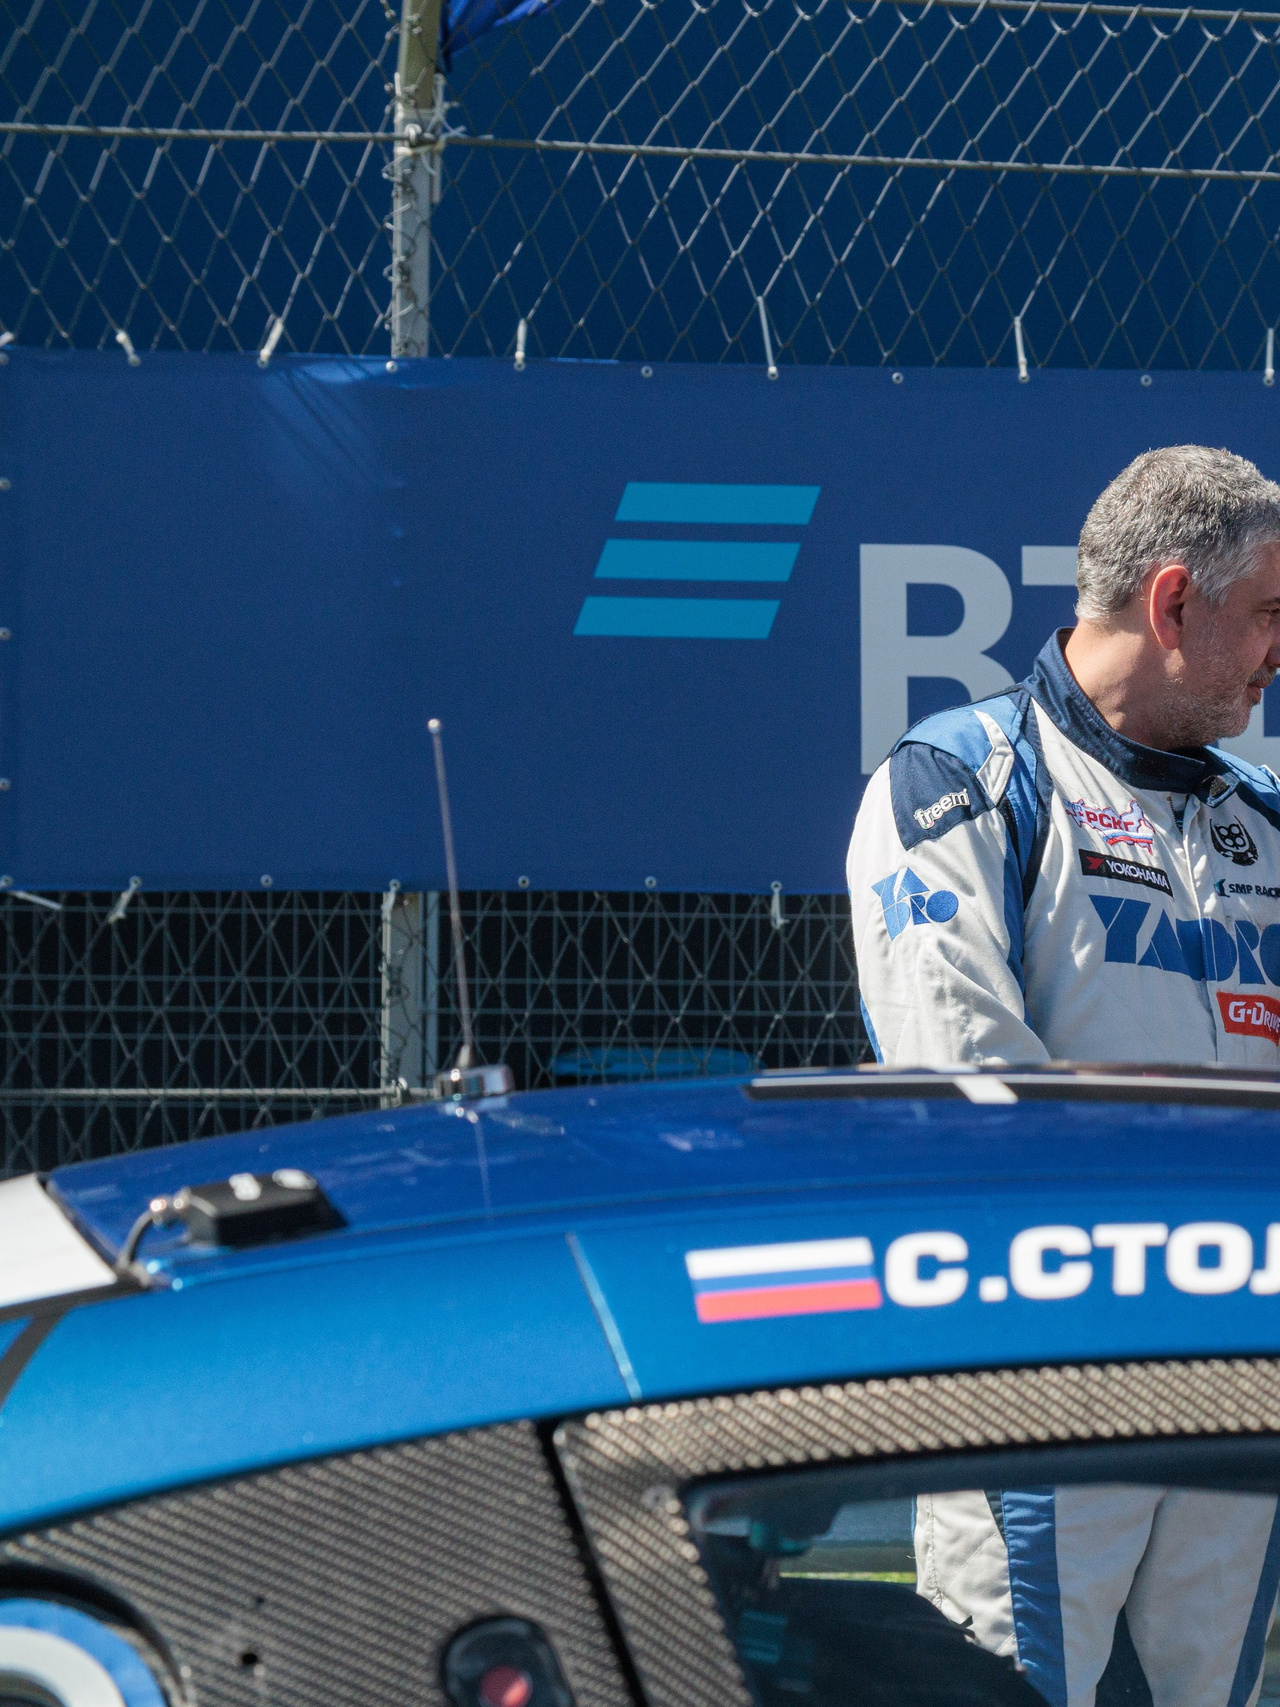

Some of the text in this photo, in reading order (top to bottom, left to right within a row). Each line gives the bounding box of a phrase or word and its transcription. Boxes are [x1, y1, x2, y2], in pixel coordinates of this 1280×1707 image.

[914, 788, 971, 829] freem
[1105, 859, 1170, 889] YOKOHAMA
[1228, 883, 1253, 895] SMP
